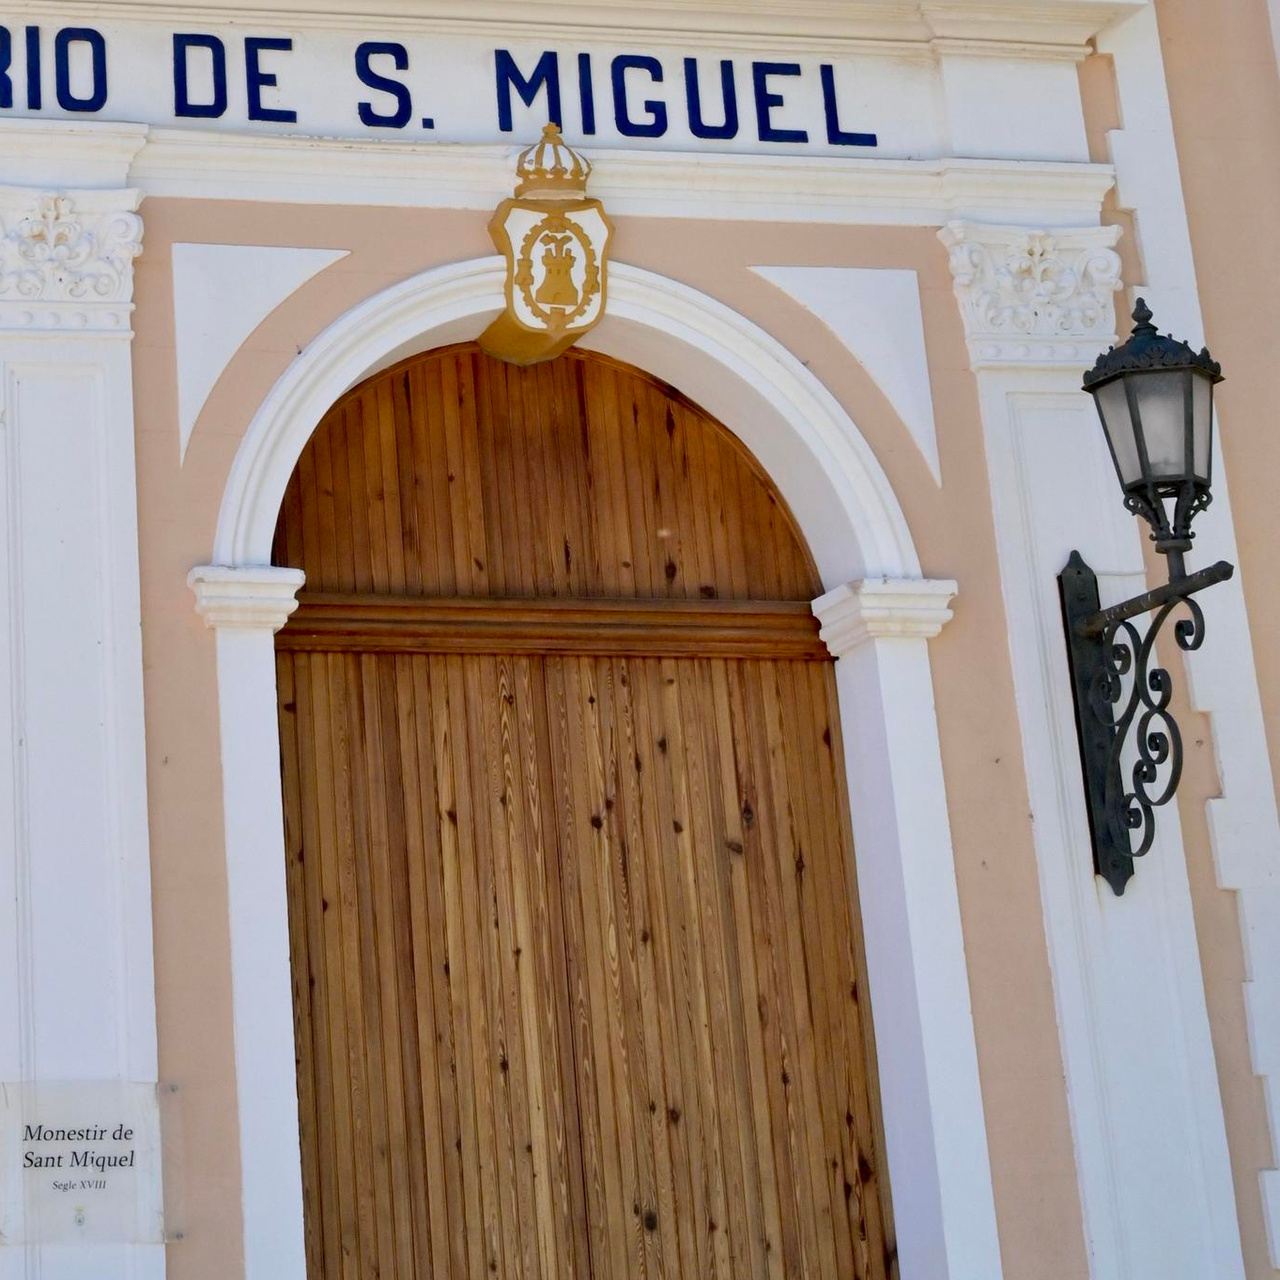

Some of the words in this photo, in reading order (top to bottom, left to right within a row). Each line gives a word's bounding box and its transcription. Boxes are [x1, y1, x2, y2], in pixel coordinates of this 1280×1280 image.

[172, 33, 298, 123] DE
[354, 41, 434, 131] S.
[494, 48, 879, 148] MIGUEL
[22, 1123, 108, 1142] Monestir
[111, 1123, 134, 1141] de
[22, 1150, 64, 1169] Sant
[69, 1149, 135, 1173] Miquel
[51, 1179, 77, 1193] Segle
[79, 1179, 107, 1191] XVIII
